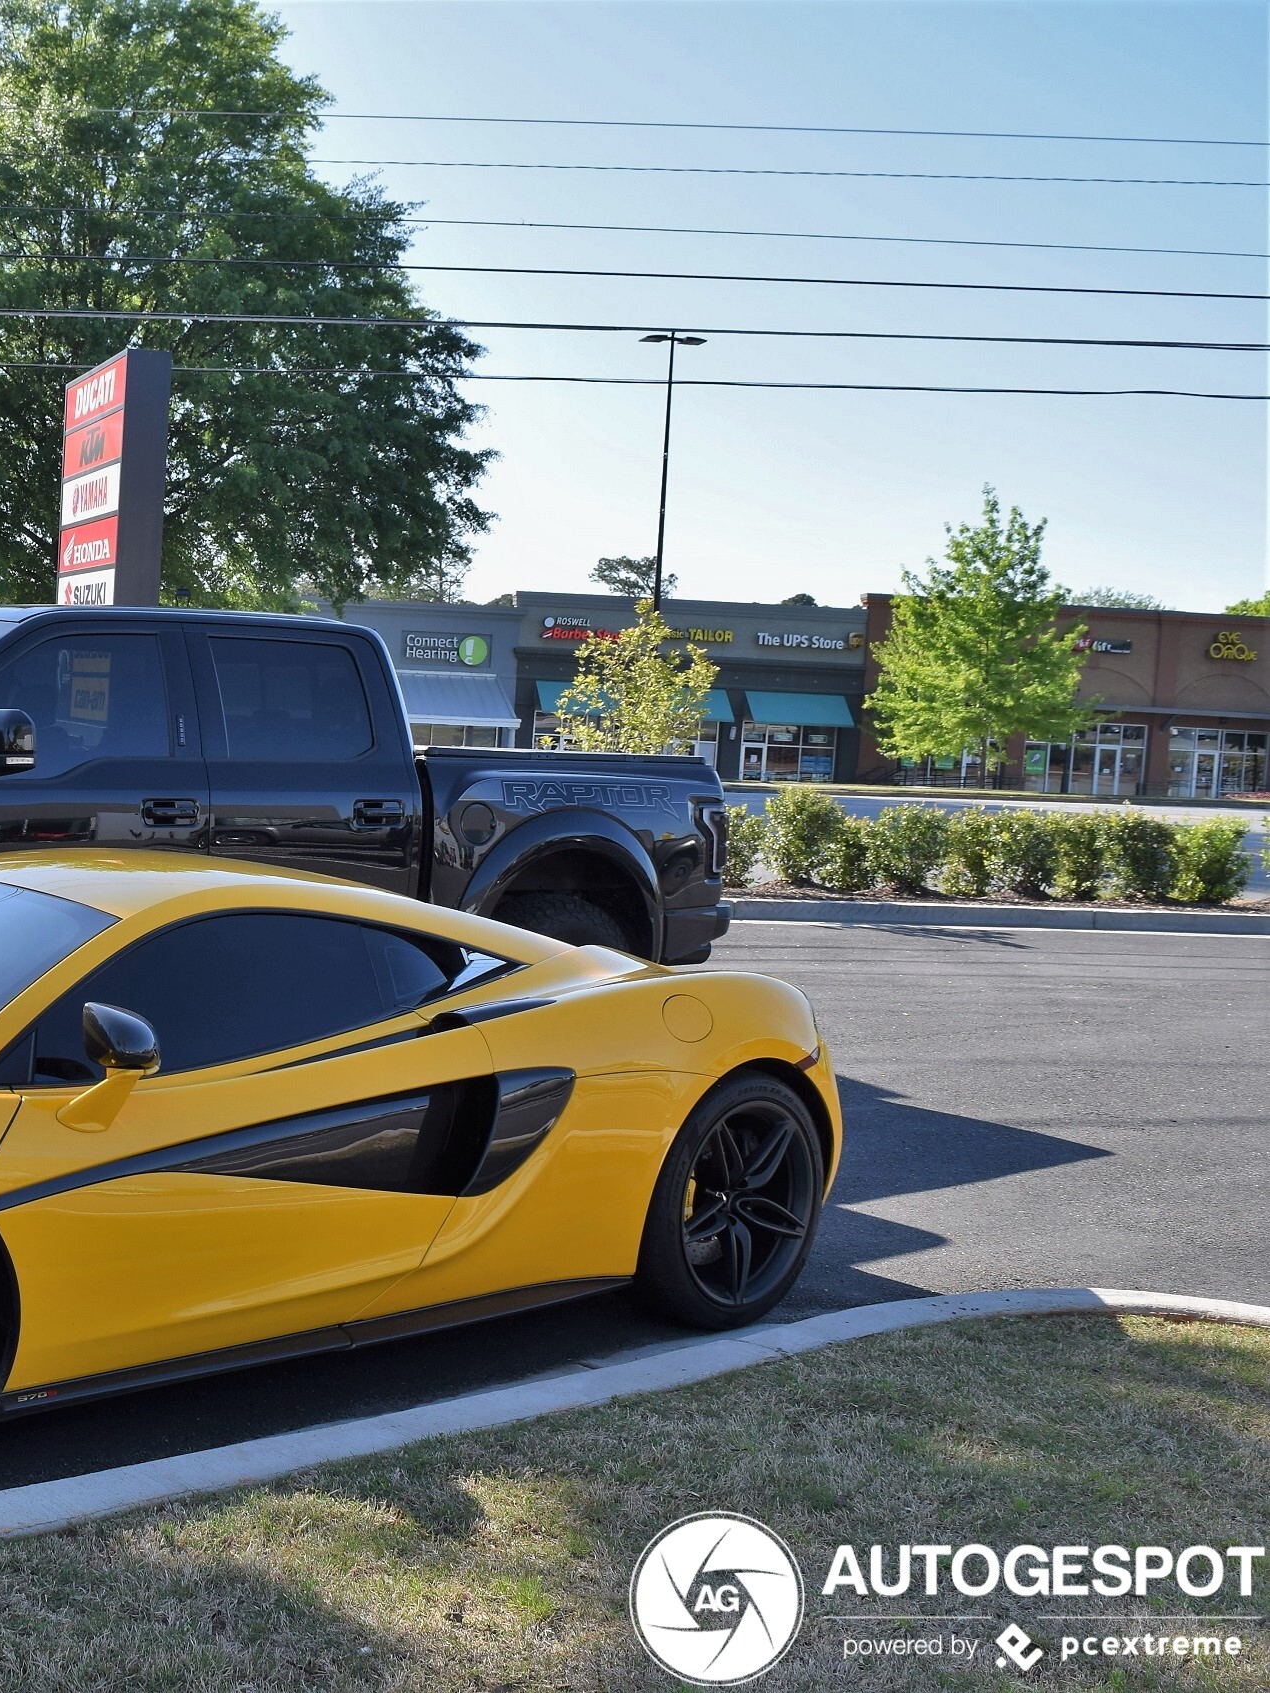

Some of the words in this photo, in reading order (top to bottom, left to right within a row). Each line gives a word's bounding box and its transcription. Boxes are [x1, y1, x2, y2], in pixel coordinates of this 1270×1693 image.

[74, 368, 116, 420] DUCATI
[79, 426, 106, 468] KTM
[80, 476, 108, 512] YAMAHA
[73, 538, 110, 565] HONDA
[73, 582, 107, 605] SUZUKI
[556, 617, 591, 627] ROSWELL
[406, 634, 458, 648] Connect
[553, 627, 591, 640] Barbe
[596, 628, 623, 642] Sho
[688, 628, 734, 642] TAILOR
[757, 632, 780, 646] The
[783, 634, 809, 648] UPS
[811, 636, 844, 650] Store
[1218, 631, 1242, 643] EYE
[406, 647, 458, 663] Hearing
[503, 781, 680, 821] RAPTOR
